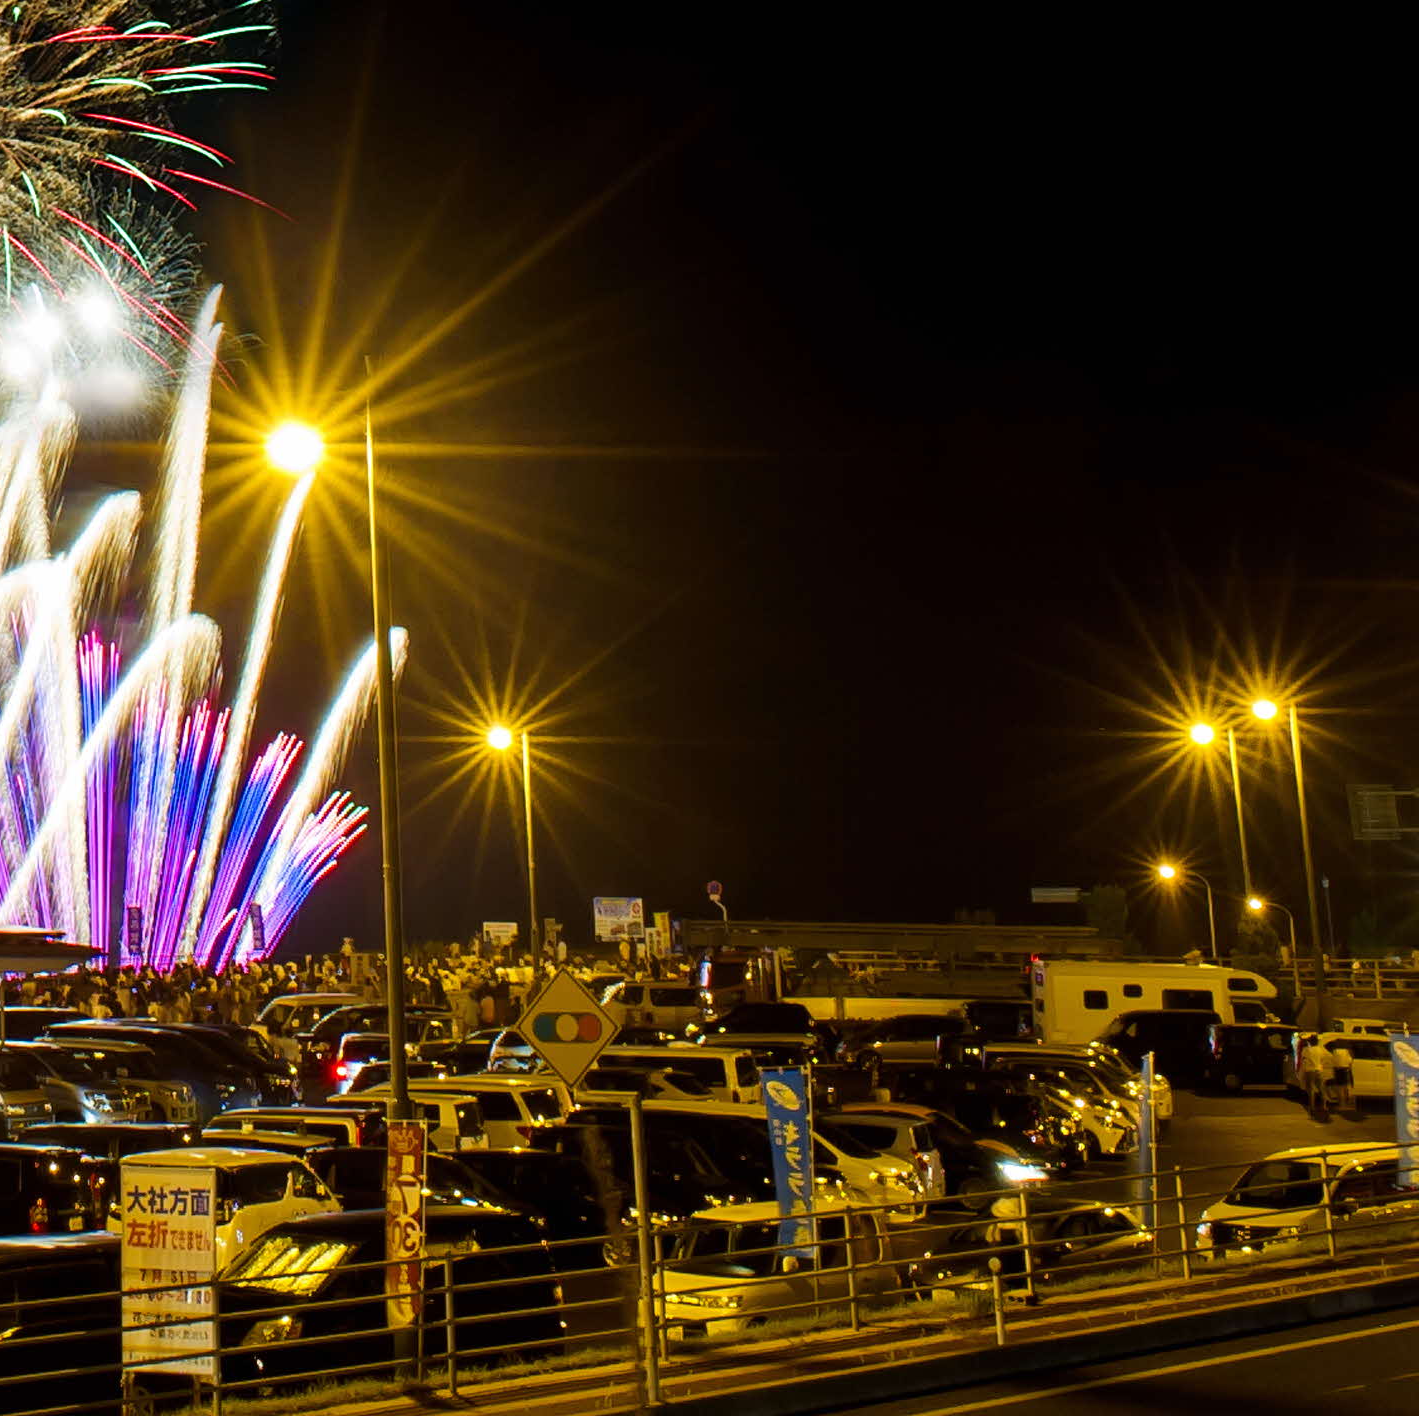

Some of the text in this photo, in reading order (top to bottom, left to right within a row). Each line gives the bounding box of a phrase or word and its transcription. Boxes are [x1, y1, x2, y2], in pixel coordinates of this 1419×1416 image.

[127, 1185, 211, 1216] 大社方面
[127, 1220, 211, 1251] 左折できません
